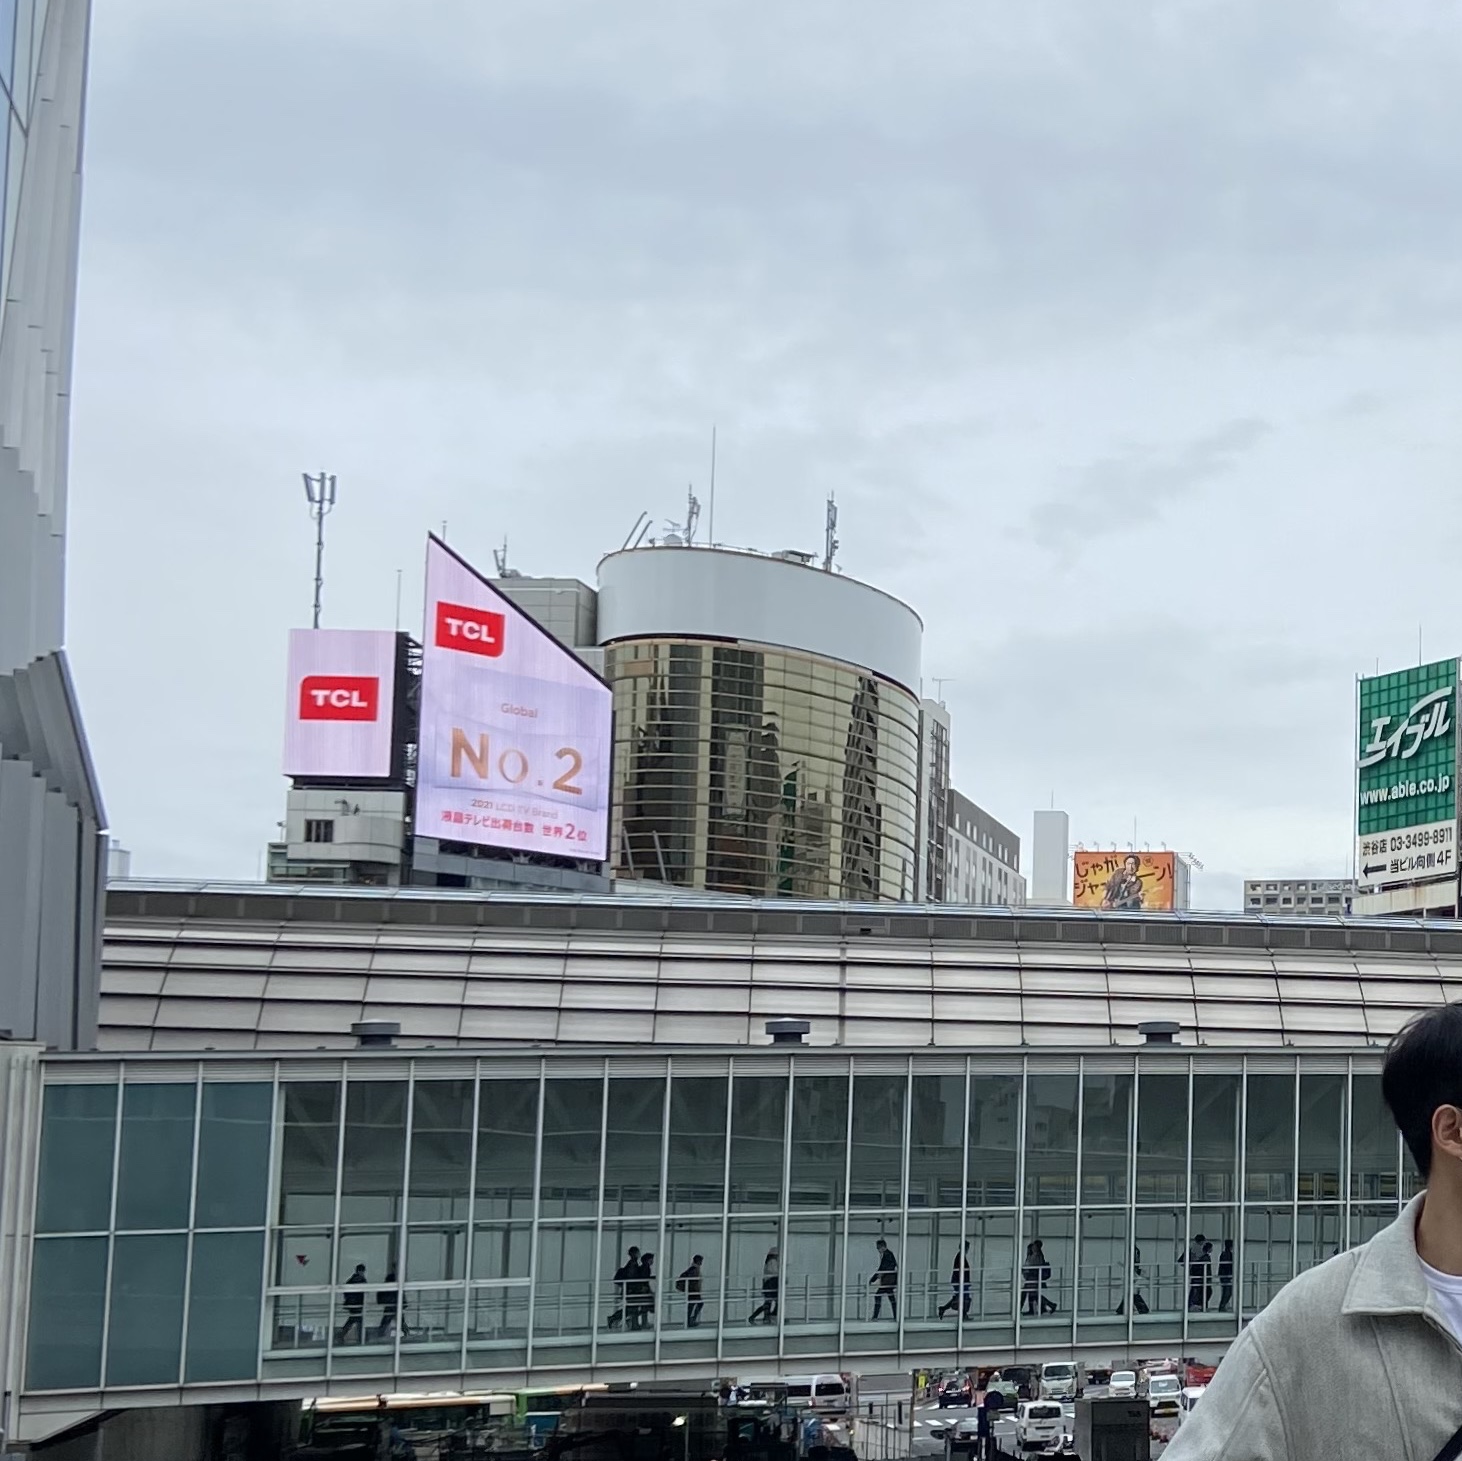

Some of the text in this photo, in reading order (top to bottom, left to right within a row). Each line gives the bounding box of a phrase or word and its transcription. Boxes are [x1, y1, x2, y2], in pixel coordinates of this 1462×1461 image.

[445, 618, 495, 643] TCL
[311, 689, 368, 708] TCL
[501, 703, 538, 719] Global
[1357, 686, 1453, 769] エイブル
[1360, 774, 1450, 805] www.able.co.jp
[1363, 827, 1452, 857] 渋谷店 03-3499-8911
[1437, 849, 1452, 866] 4F
